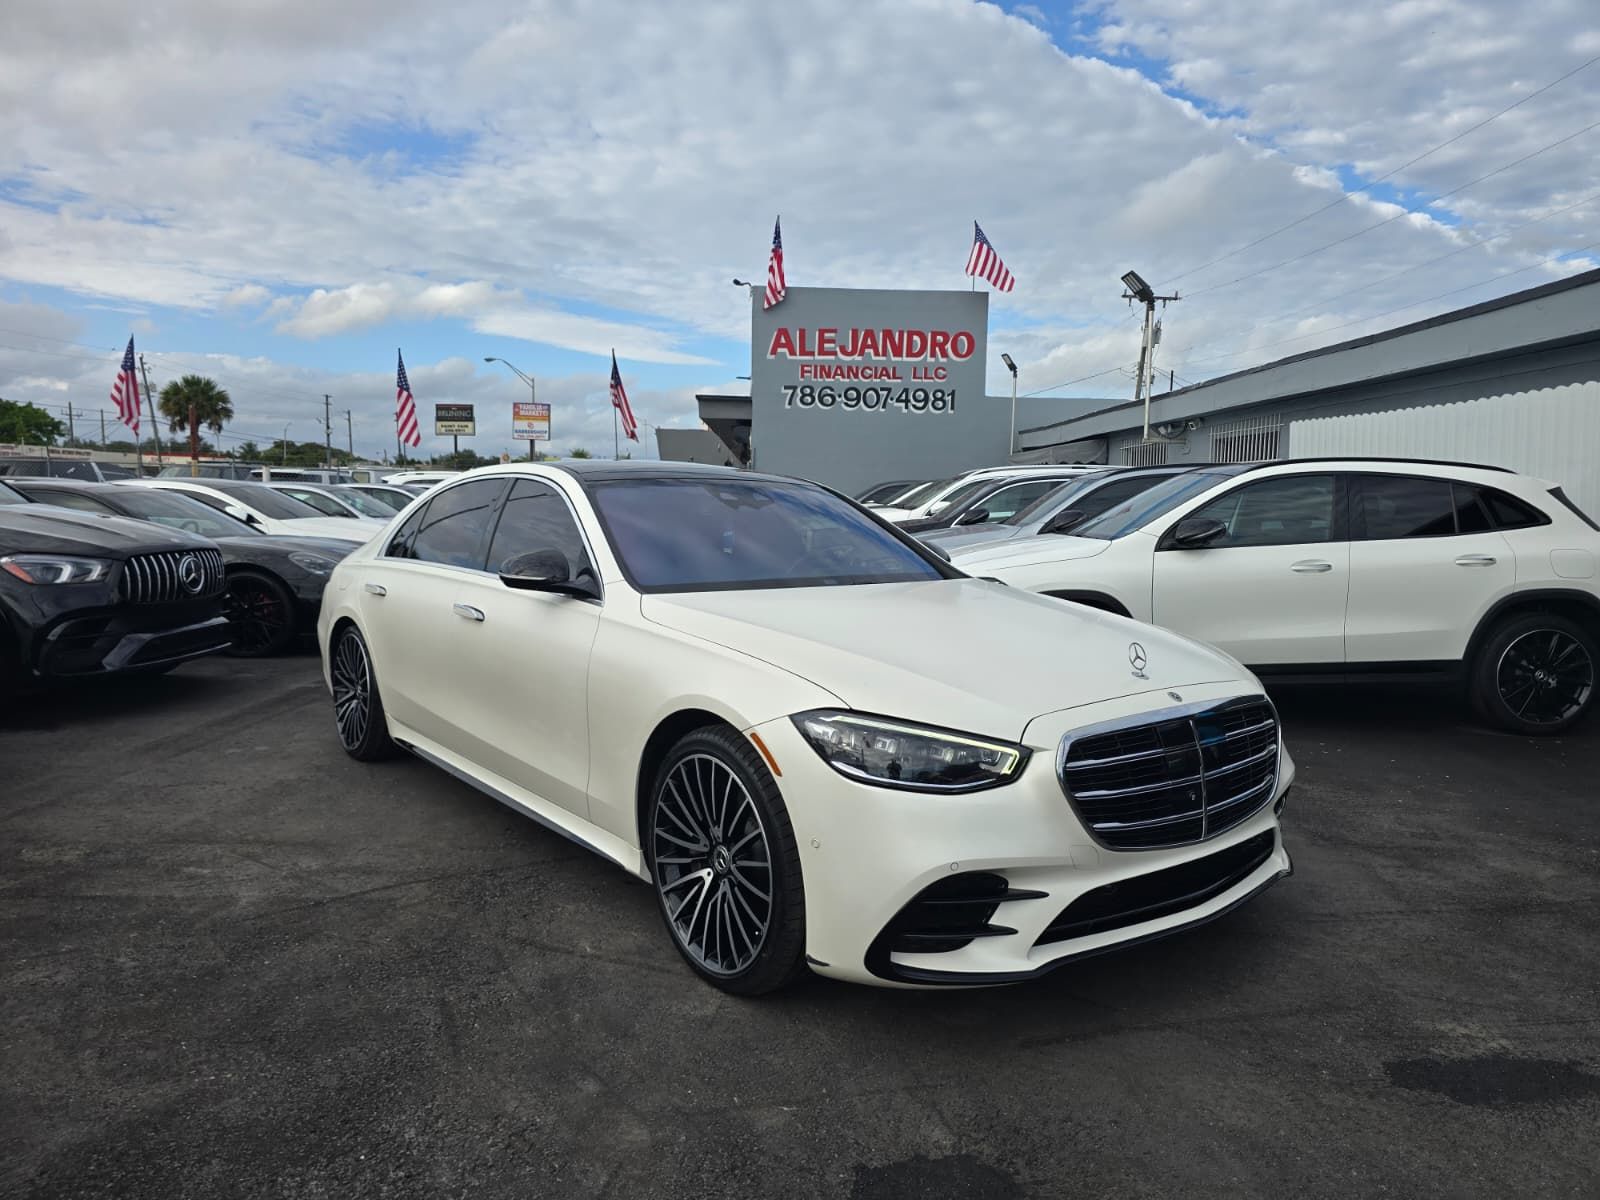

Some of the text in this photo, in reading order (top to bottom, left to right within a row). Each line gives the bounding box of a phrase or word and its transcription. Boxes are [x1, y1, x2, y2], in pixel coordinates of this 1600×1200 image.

[768, 328, 976, 360] ALEJANDRO
[800, 364, 948, 382] FINANCIAL LLC
